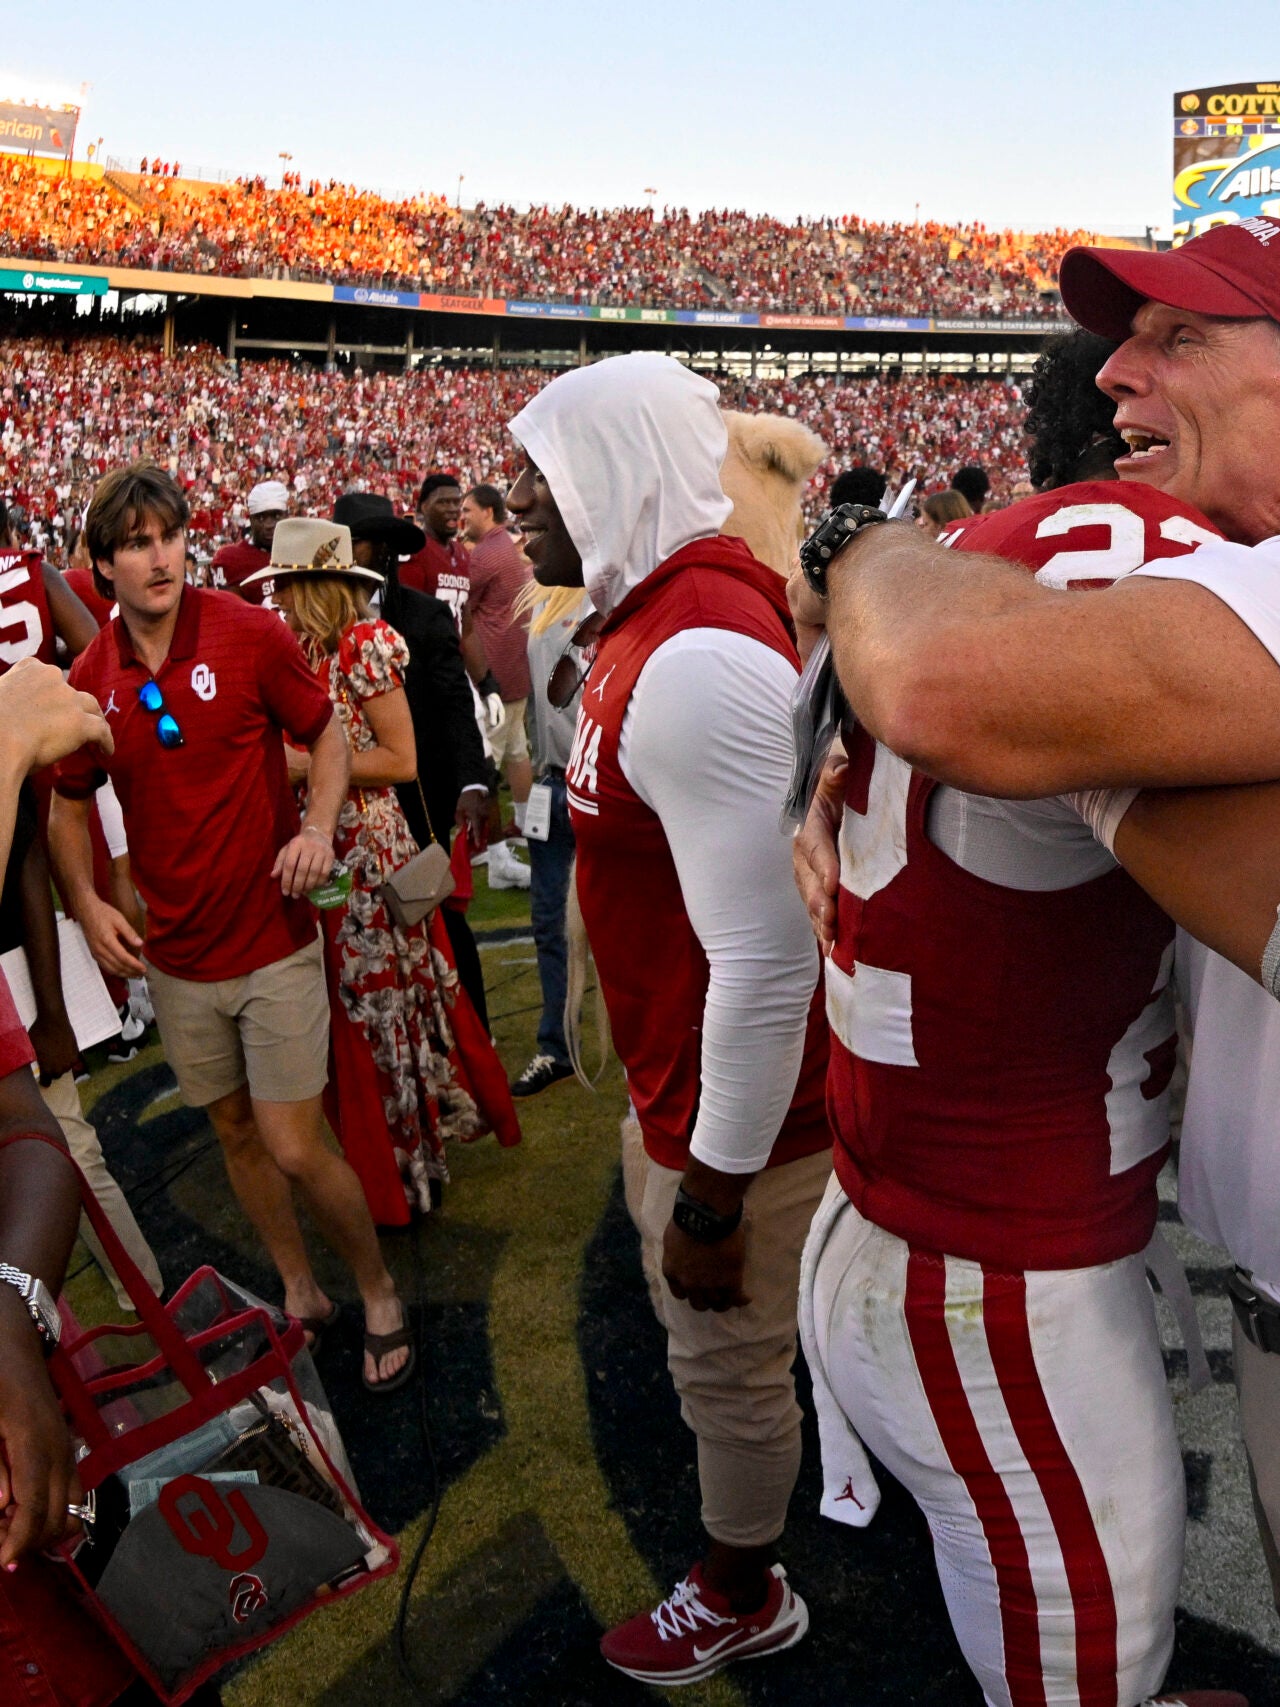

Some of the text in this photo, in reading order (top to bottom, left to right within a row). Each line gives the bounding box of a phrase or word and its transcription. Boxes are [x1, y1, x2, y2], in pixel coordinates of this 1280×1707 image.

[368, 291, 399, 304] Allstate
[440, 297, 485, 311] SEATGEEK
[695, 312, 741, 323] BUD LIGHT
[437, 572, 471, 592] SOONERS
[191, 663, 217, 702] OU
